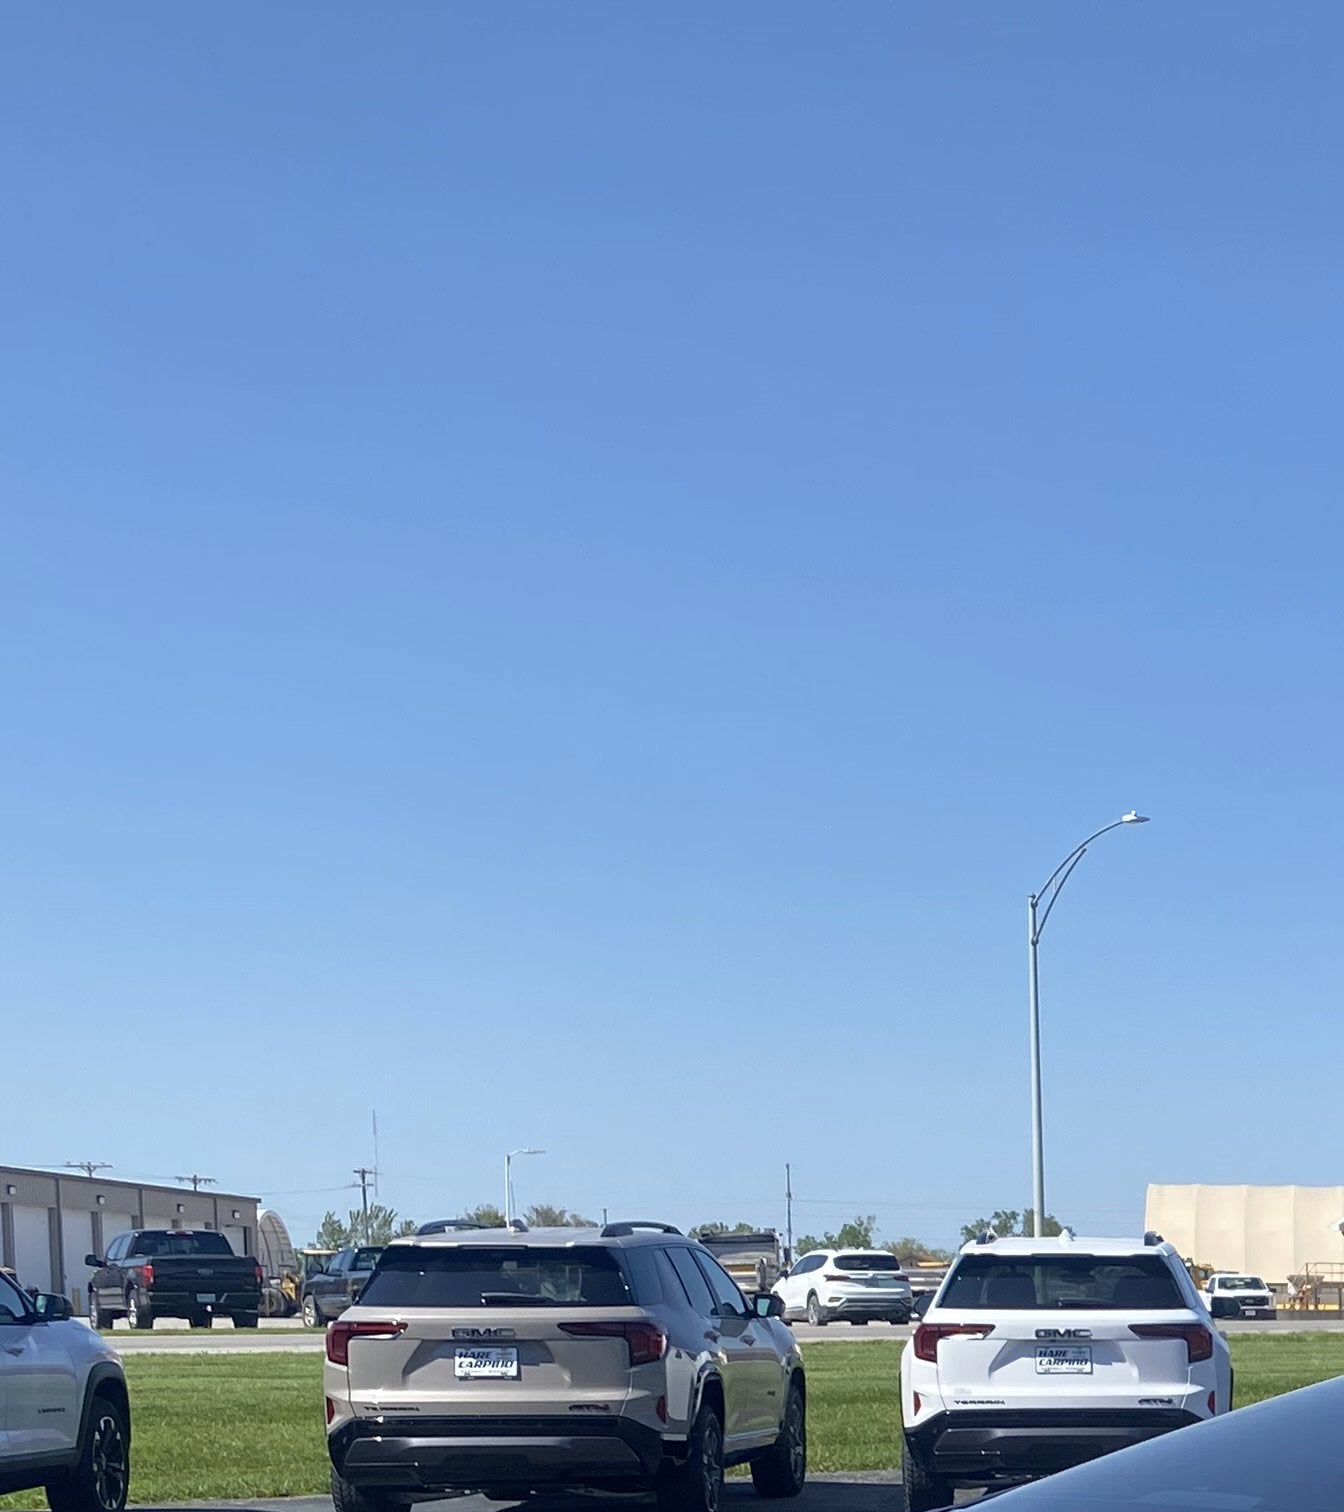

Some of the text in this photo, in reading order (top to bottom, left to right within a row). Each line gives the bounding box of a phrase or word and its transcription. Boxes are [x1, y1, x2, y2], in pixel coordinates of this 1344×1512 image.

[451, 1327, 516, 1340] GMC
[1034, 1328, 1093, 1339] GMC
[458, 1350, 493, 1360] HARE
[1038, 1350, 1069, 1358] HARE
[458, 1359, 515, 1369] CARPINO
[1039, 1358, 1089, 1367] CARPINO
